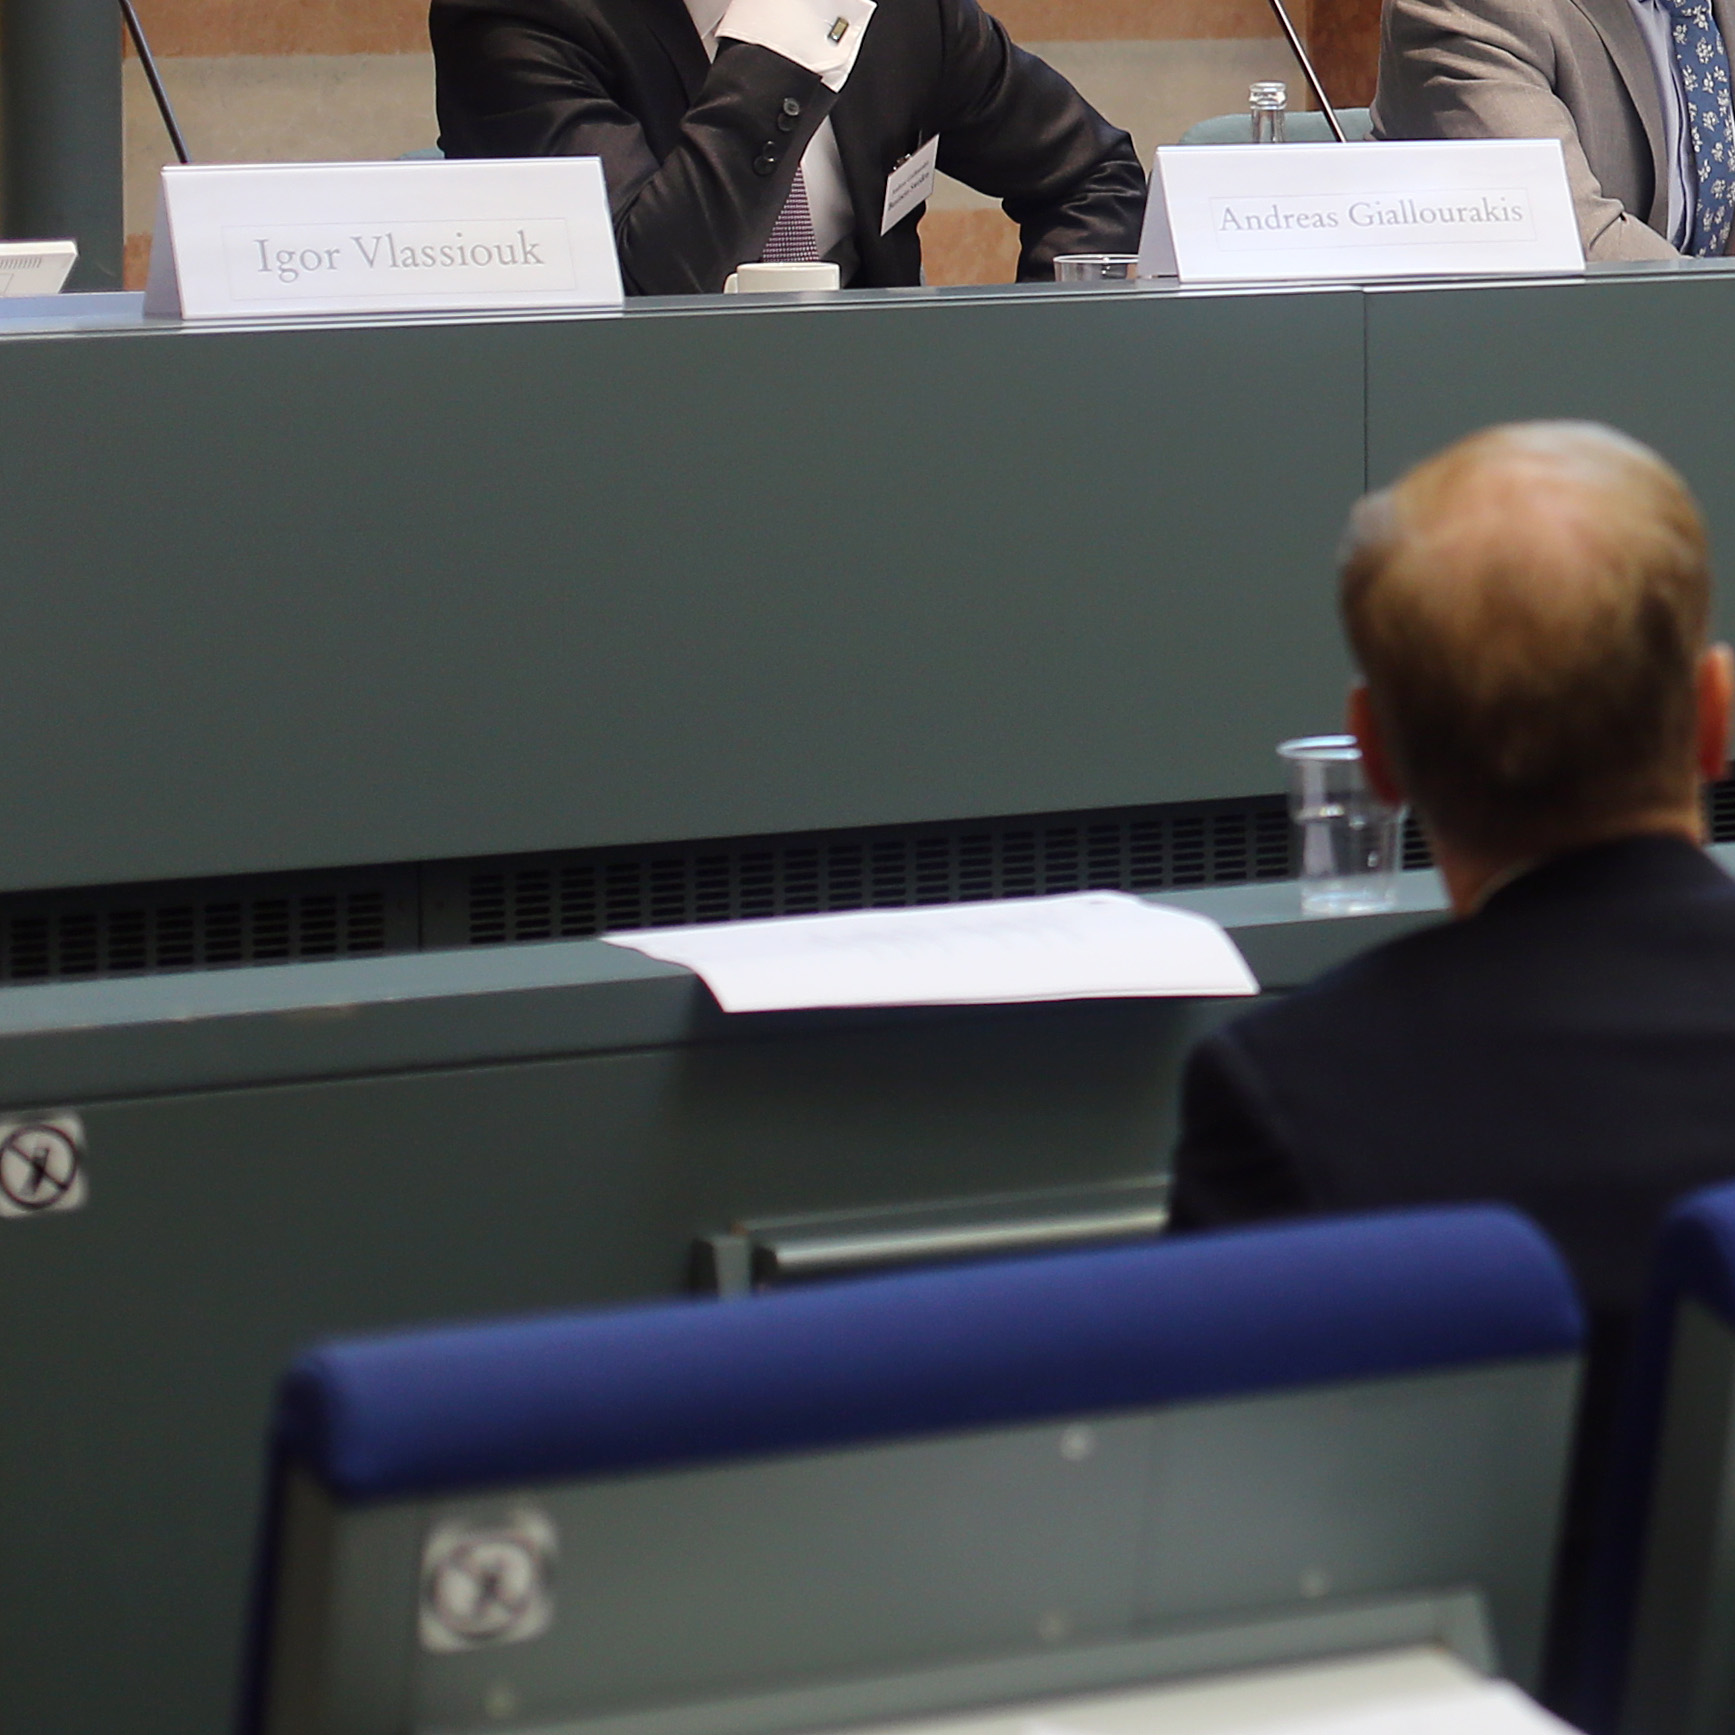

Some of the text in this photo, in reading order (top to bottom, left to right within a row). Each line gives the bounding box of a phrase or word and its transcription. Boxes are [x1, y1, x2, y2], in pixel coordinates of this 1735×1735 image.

[1218, 195, 1524, 233] Andreas Giallourakis
[254, 229, 545, 284] Igor Vlassiouk
